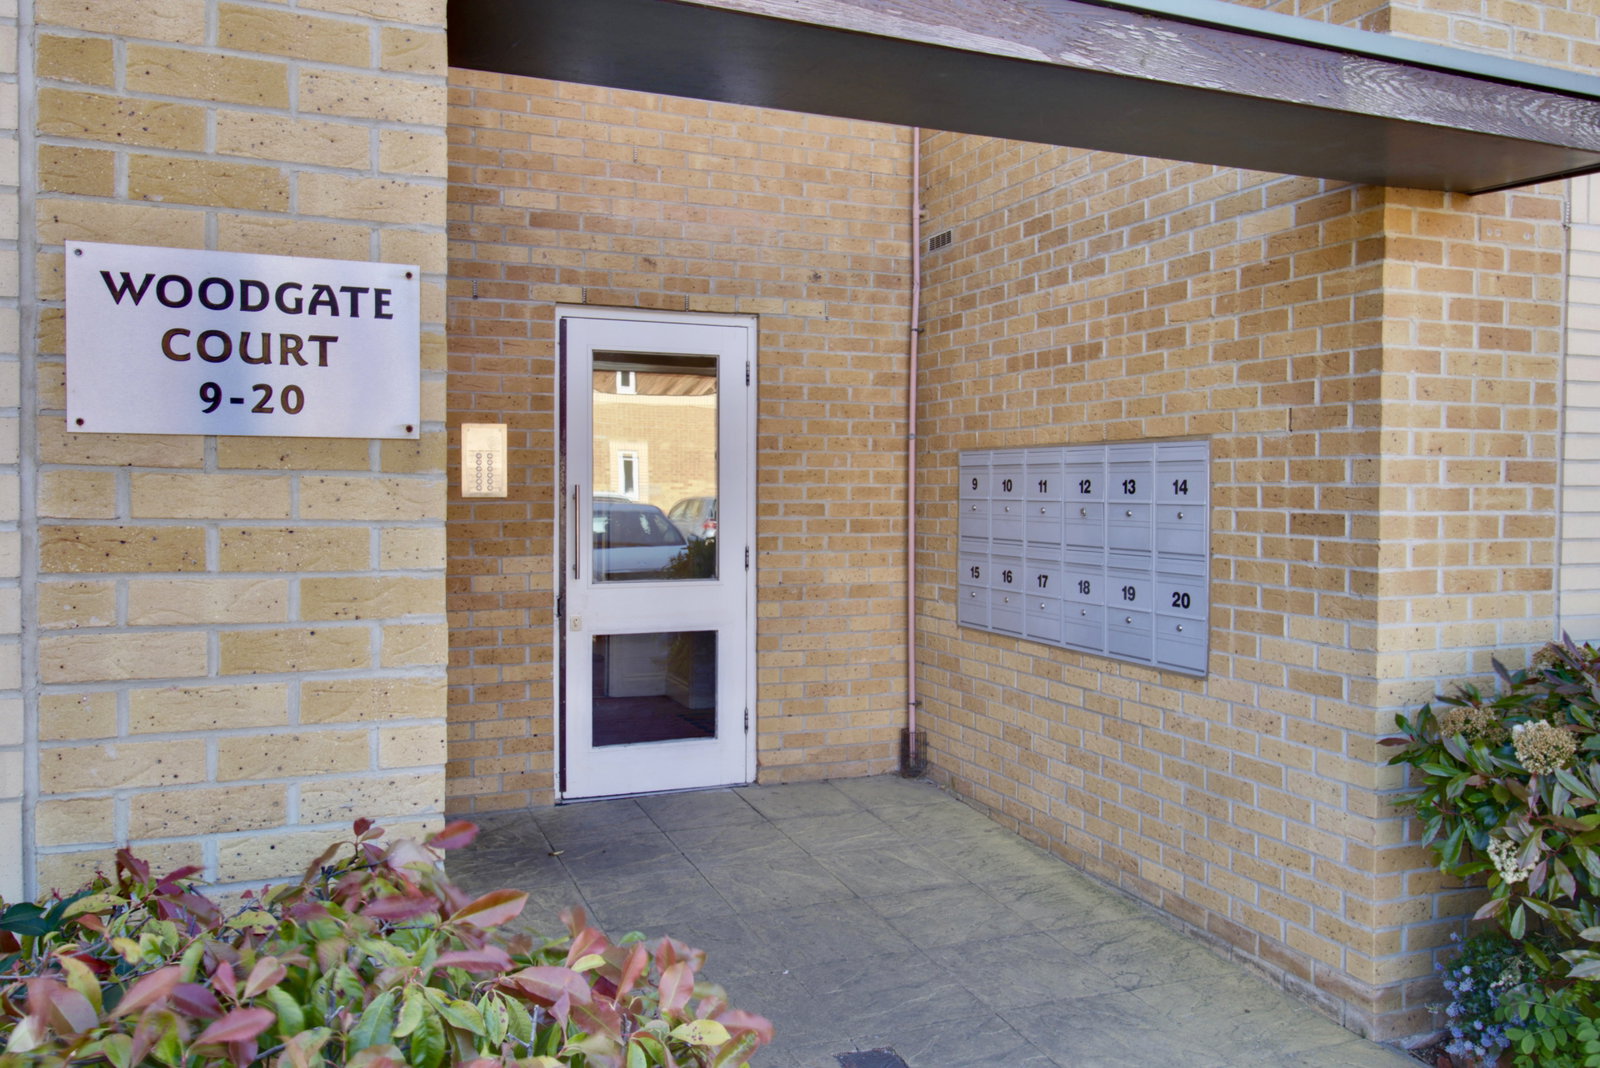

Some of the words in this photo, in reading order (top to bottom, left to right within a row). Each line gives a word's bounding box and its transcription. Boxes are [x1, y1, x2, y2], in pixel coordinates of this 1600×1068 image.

[99, 270, 394, 320] WOODGATE
[161, 327, 339, 367] COURT
[199, 381, 305, 415] 9-20
[971, 477, 978, 491] 9
[1002, 479, 1013, 493] 10
[1038, 479, 1048, 493] 11
[1078, 479, 1091, 494] 12
[1122, 479, 1136, 495] 13
[1172, 479, 1189, 495] 14
[970, 566, 980, 579] 15
[1002, 569, 1013, 584] 16
[1037, 574, 1048, 588] 17
[1078, 580, 1090, 595] 18
[1121, 585, 1136, 601] 19
[1171, 592, 1191, 609] 20
